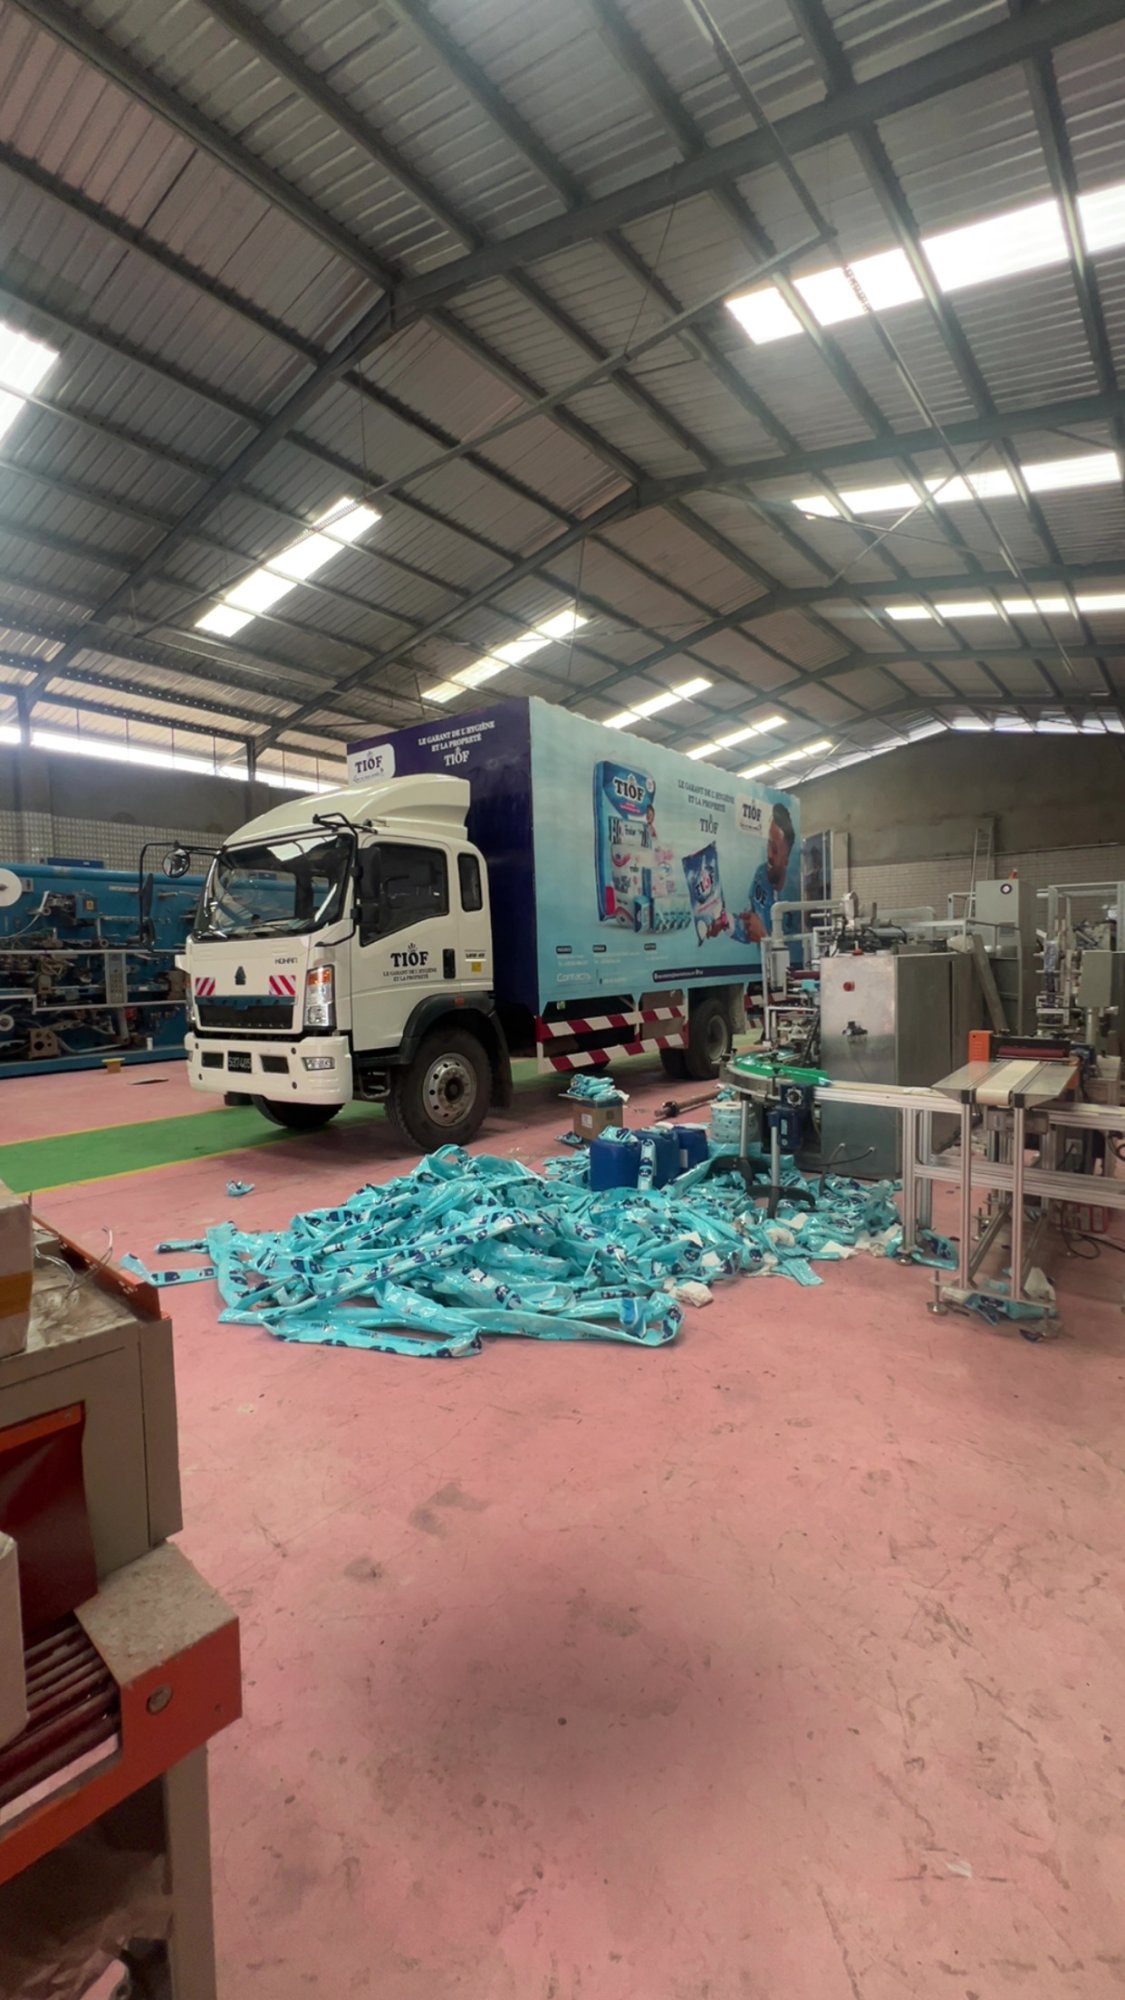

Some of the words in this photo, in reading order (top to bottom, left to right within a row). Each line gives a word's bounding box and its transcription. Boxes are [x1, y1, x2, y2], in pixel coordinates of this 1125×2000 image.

[418, 738, 426, 746] LE
[427, 731, 451, 744] GARANT
[452, 728, 460, 738] DE
[431, 743, 440, 752] ET
[440, 742, 449, 750] LA
[354, 755, 383, 774] TIOF
[613, 778, 645, 802] TIOF
[390, 951, 429, 968] TIOF
